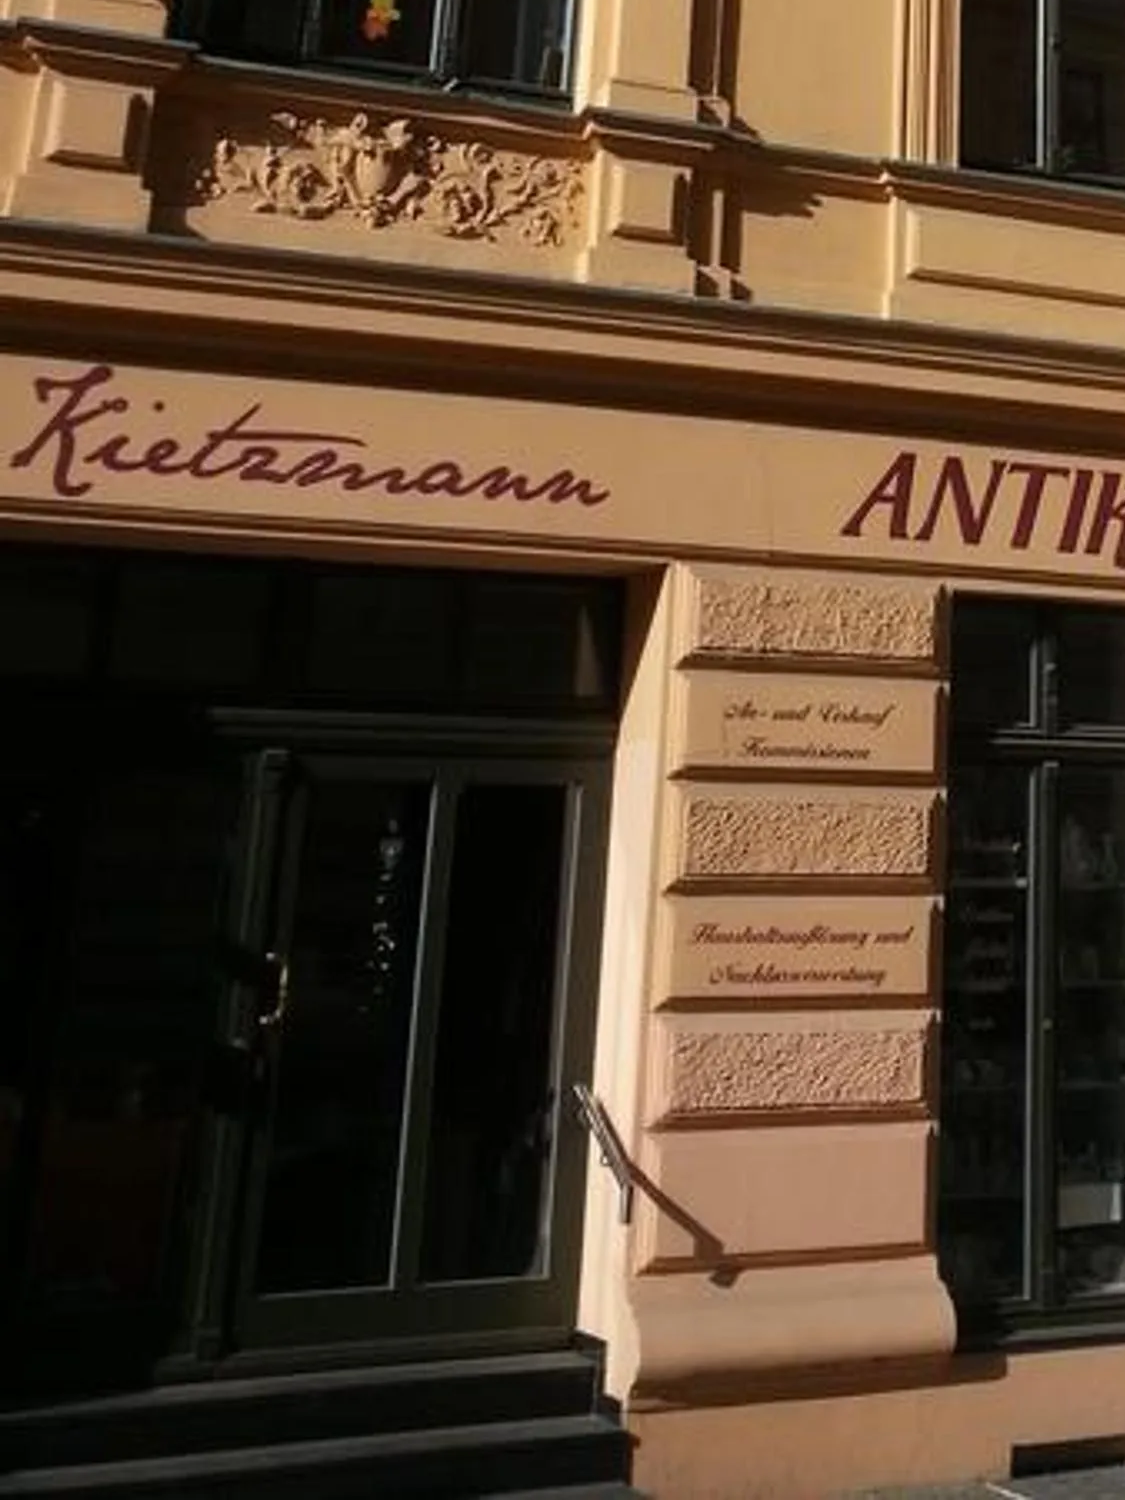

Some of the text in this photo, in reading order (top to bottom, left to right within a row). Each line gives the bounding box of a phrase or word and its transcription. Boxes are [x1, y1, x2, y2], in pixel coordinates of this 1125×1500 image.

[10, 364, 610, 507] Kietzmann
[773, 705, 812, 721] und
[874, 926, 914, 944] und
